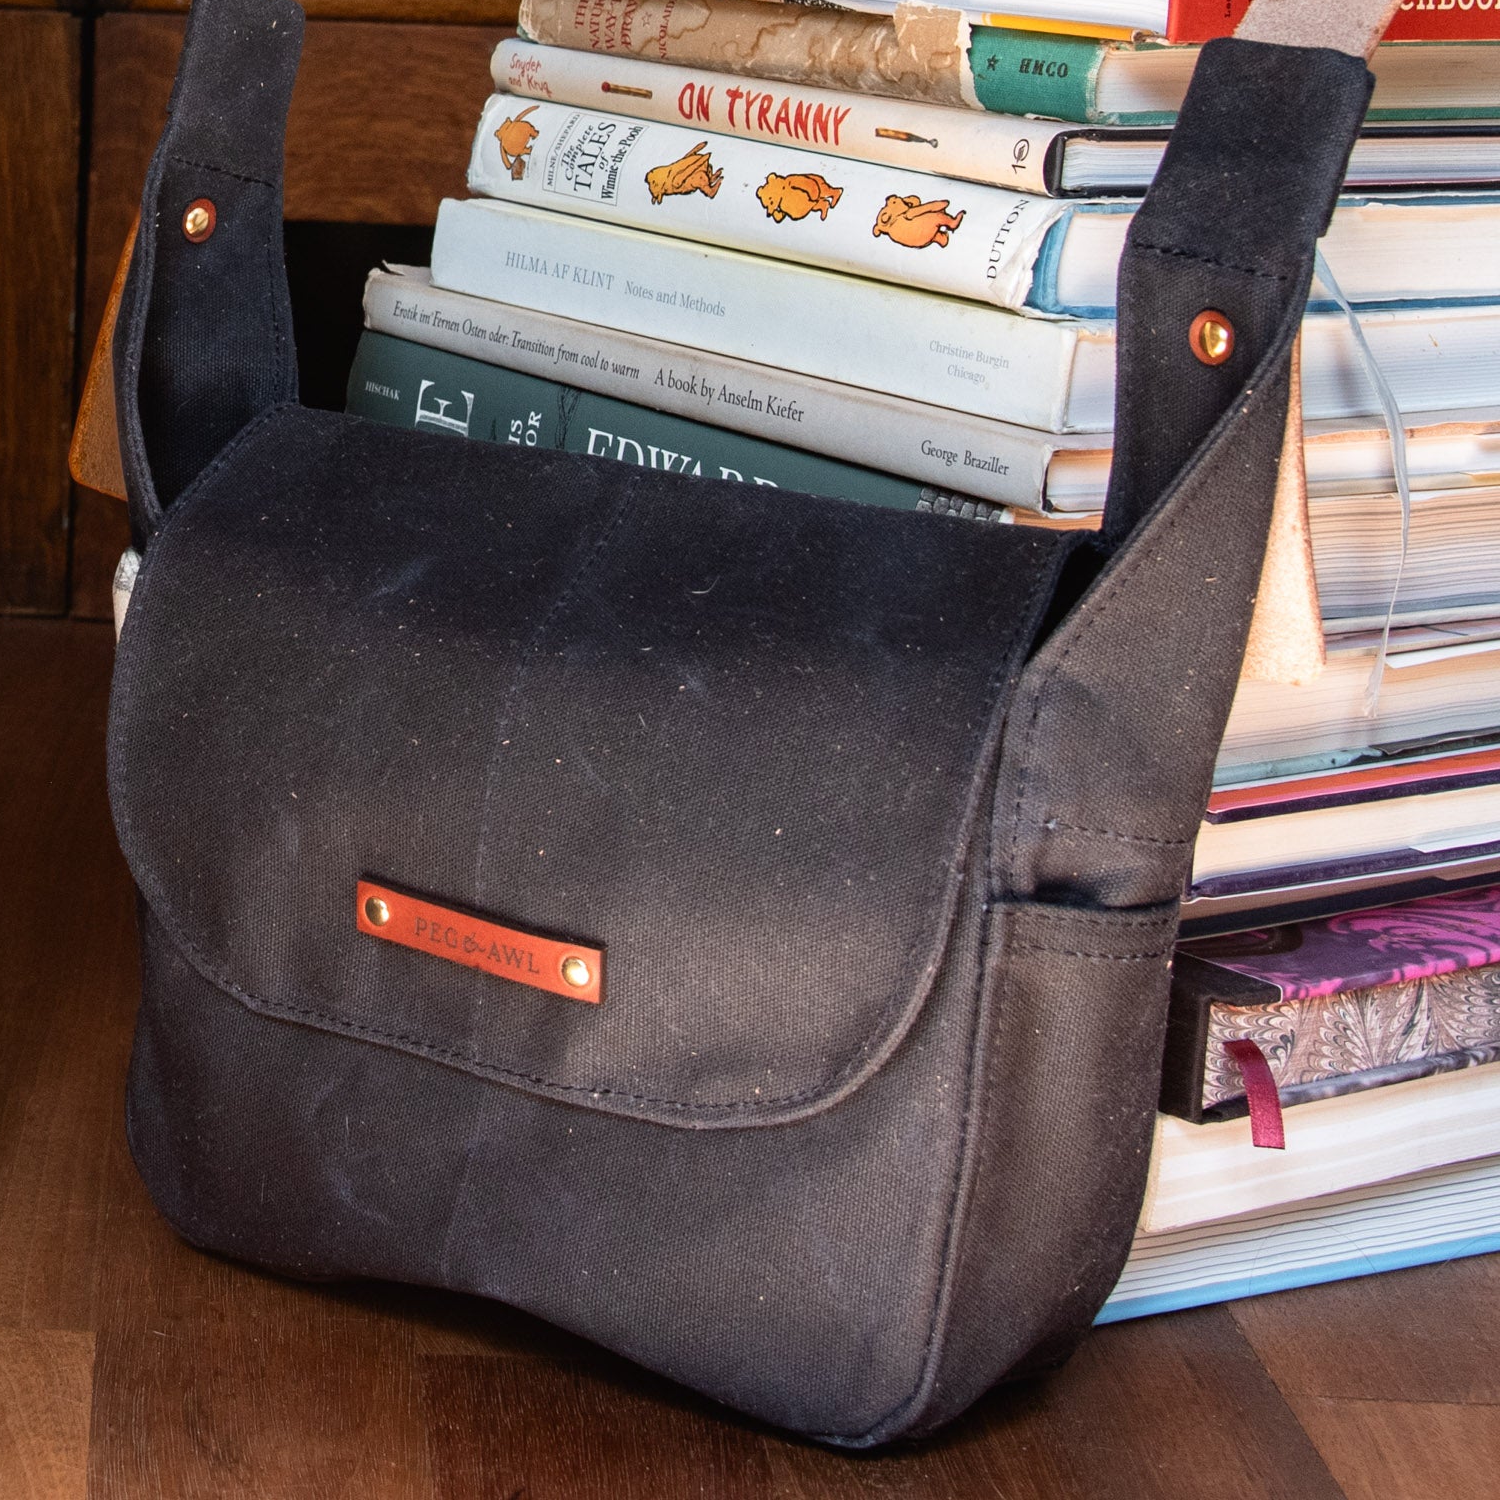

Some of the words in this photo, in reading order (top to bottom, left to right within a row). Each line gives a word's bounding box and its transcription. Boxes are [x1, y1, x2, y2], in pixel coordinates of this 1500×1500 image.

[509, 52, 542, 78] Snyder
[1019, 57, 1069, 79] HMCO
[678, 81, 714, 122] ON
[726, 84, 852, 146] TYRANNY
[601, 124, 643, 200] Winnie-the-Pooh
[986, 198, 1031, 280] DUTTON
[505, 251, 549, 277] HILMA
[551, 262, 569, 280] AF
[572, 267, 615, 291] KLINT
[624, 280, 654, 302] Notes
[656, 290, 677, 307] and
[679, 292, 727, 318] Methods
[365, 380, 401, 401] HISCHAK
[393, 300, 419, 324] Erotik
[432, 306, 460, 333] Fernen
[462, 318, 487, 340] Osten
[488, 324, 510, 346] oder:
[510, 330, 556, 358] Transition
[553, 341, 579, 366] from
[580, 347, 599, 369] cool
[600, 356, 610, 371] to
[611, 361, 641, 381] warm
[654, 368, 665, 387] A
[667, 369, 698, 397] book
[700, 377, 715, 402] by
[717, 384, 763, 412] Anselm
[765, 395, 805, 424] Kiefer
[920, 438, 960, 467] George
[963, 449, 1010, 478] Braziller
